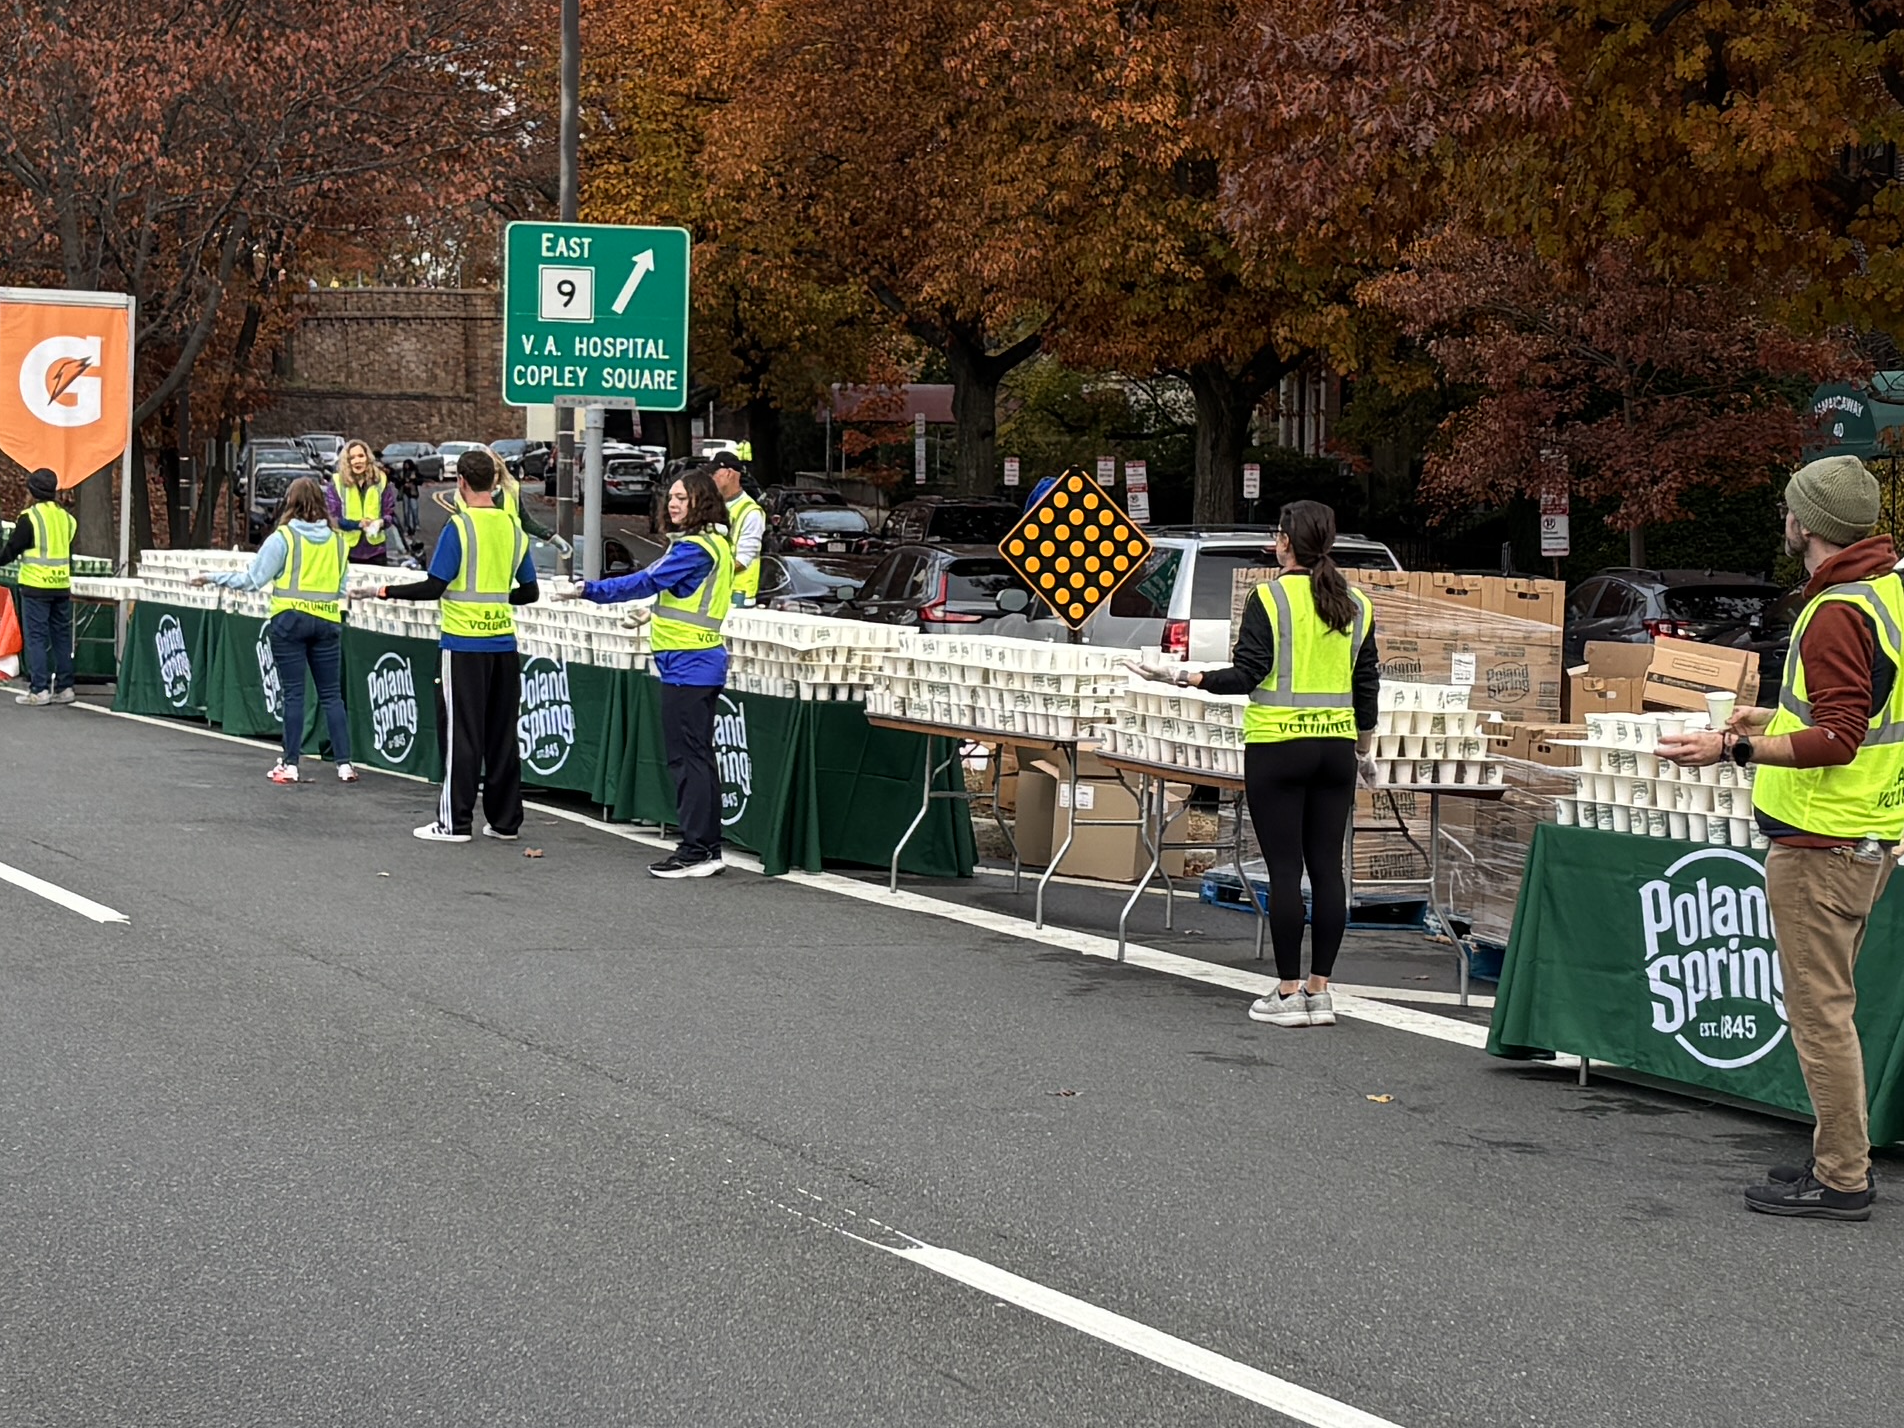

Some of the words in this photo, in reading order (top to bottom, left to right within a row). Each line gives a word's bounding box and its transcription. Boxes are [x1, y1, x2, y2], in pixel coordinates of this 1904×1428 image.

[541, 233, 592, 258] EAST
[556, 279, 576, 308] 9
[575, 336, 670, 359] HOSPITAL
[19, 335, 103, 428] G
[513, 365, 587, 387] COPLEY
[601, 367, 678, 390] SQUARE
[367, 657, 416, 711] Poland
[1487, 664, 1530, 683] Poland
[1487, 678, 1531, 700] Spring
[373, 696, 418, 748] Spring
[517, 701, 575, 760] Spring
[714, 702, 749, 750] and
[715, 746, 753, 796] ring
[1639, 877, 1776, 960] Polan
[1699, 1022, 1720, 1037] EST.
[1720, 1014, 1757, 1039] 1845
